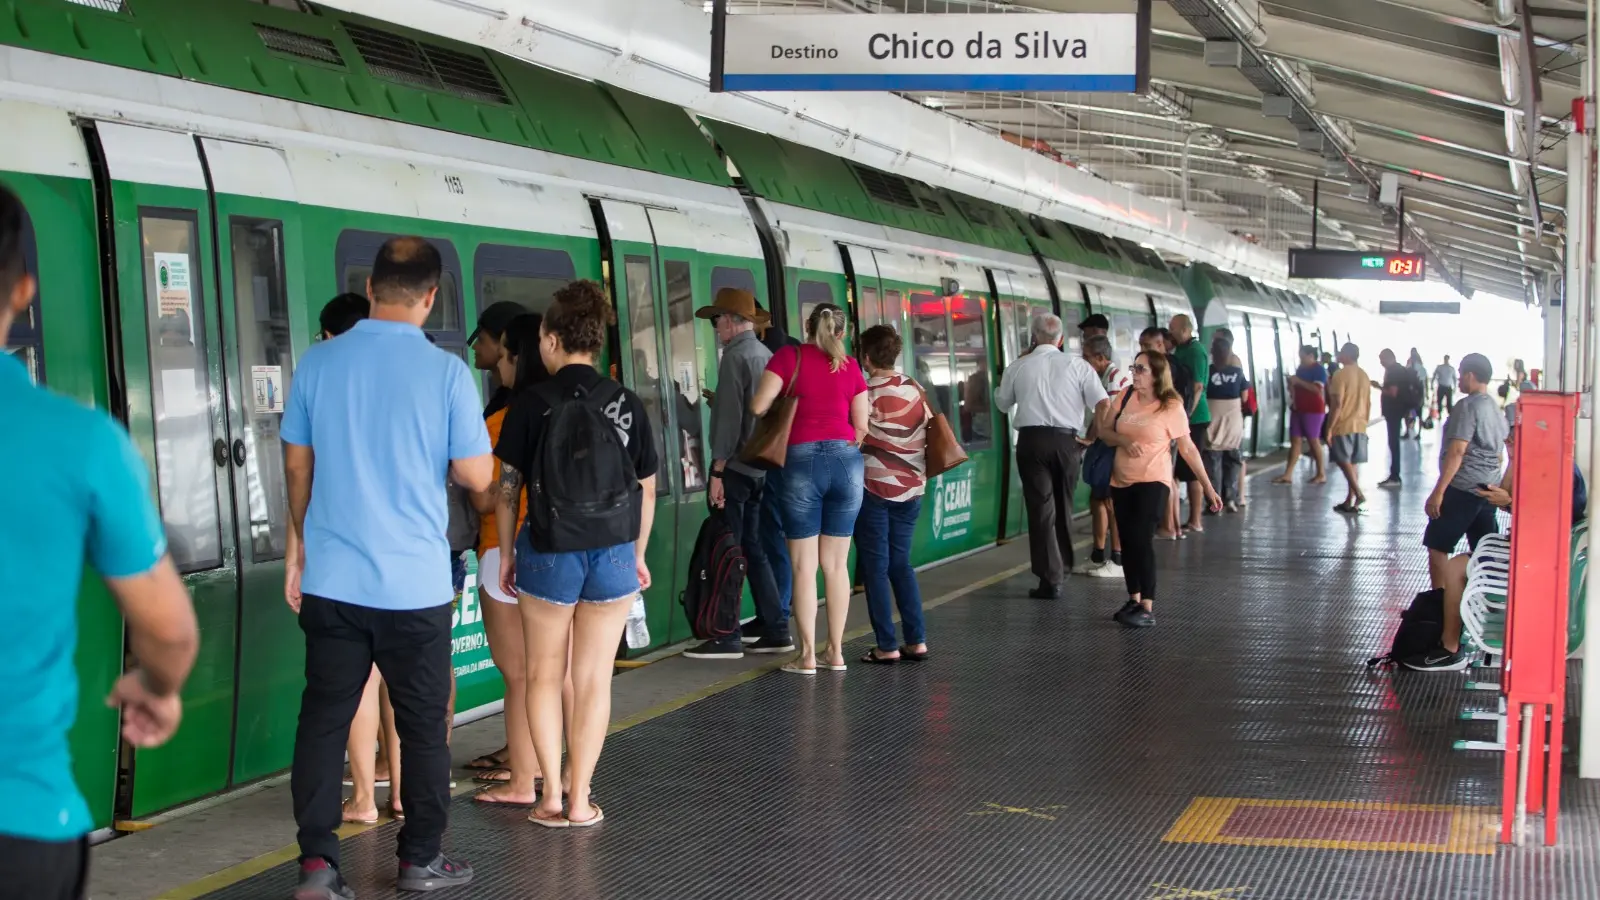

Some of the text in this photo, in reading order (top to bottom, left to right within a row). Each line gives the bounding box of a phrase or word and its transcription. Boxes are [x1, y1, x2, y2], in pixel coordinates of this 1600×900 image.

[771, 30, 1087, 60] Destino Chico da Silva
[444, 174, 464, 195] 1153
[1389, 257, 1422, 275] 10:31
[944, 468, 972, 512] CEARÁ
[450, 631, 483, 656] OVERNO
[453, 664, 470, 678] ETARIA
